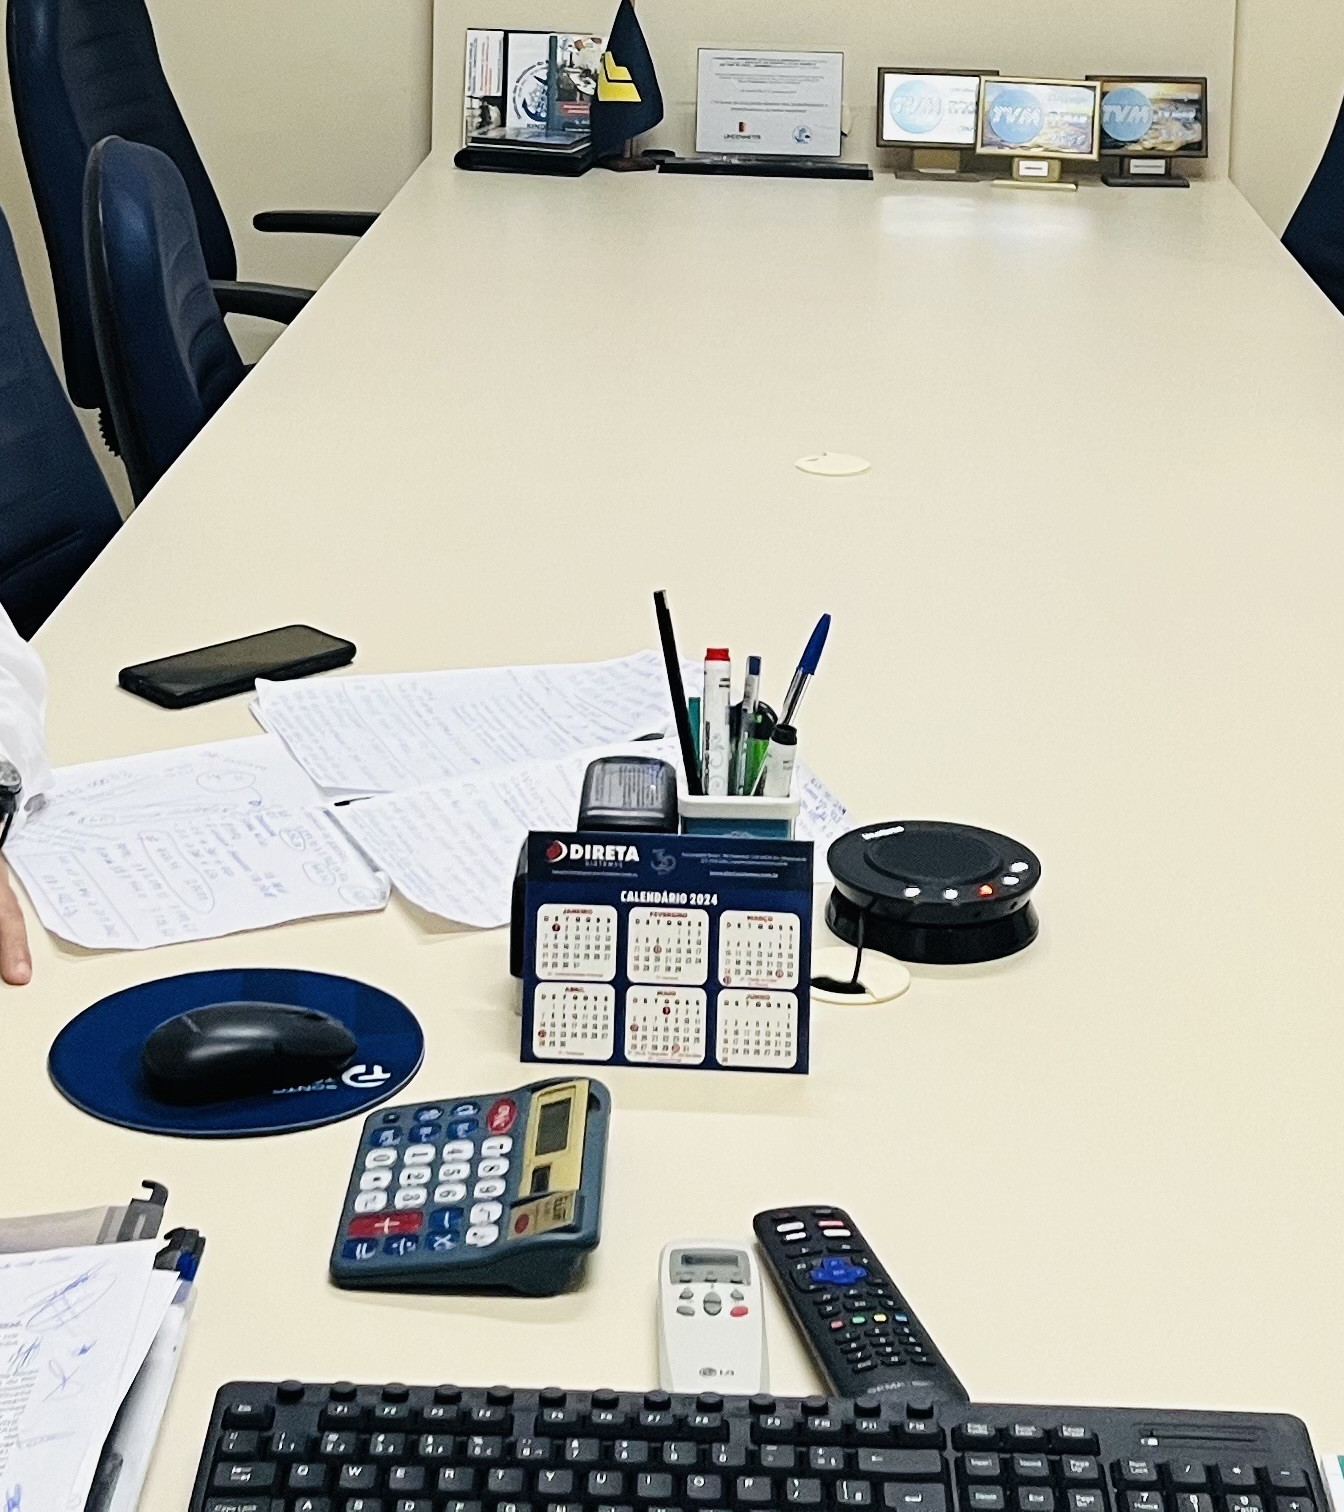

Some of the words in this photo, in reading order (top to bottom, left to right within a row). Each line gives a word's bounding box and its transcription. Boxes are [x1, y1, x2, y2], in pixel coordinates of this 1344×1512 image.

[569, 843, 640, 863] DIRETA
[620, 889, 687, 906] CALENDÁRIO
[689, 892, 719, 907] 2024
